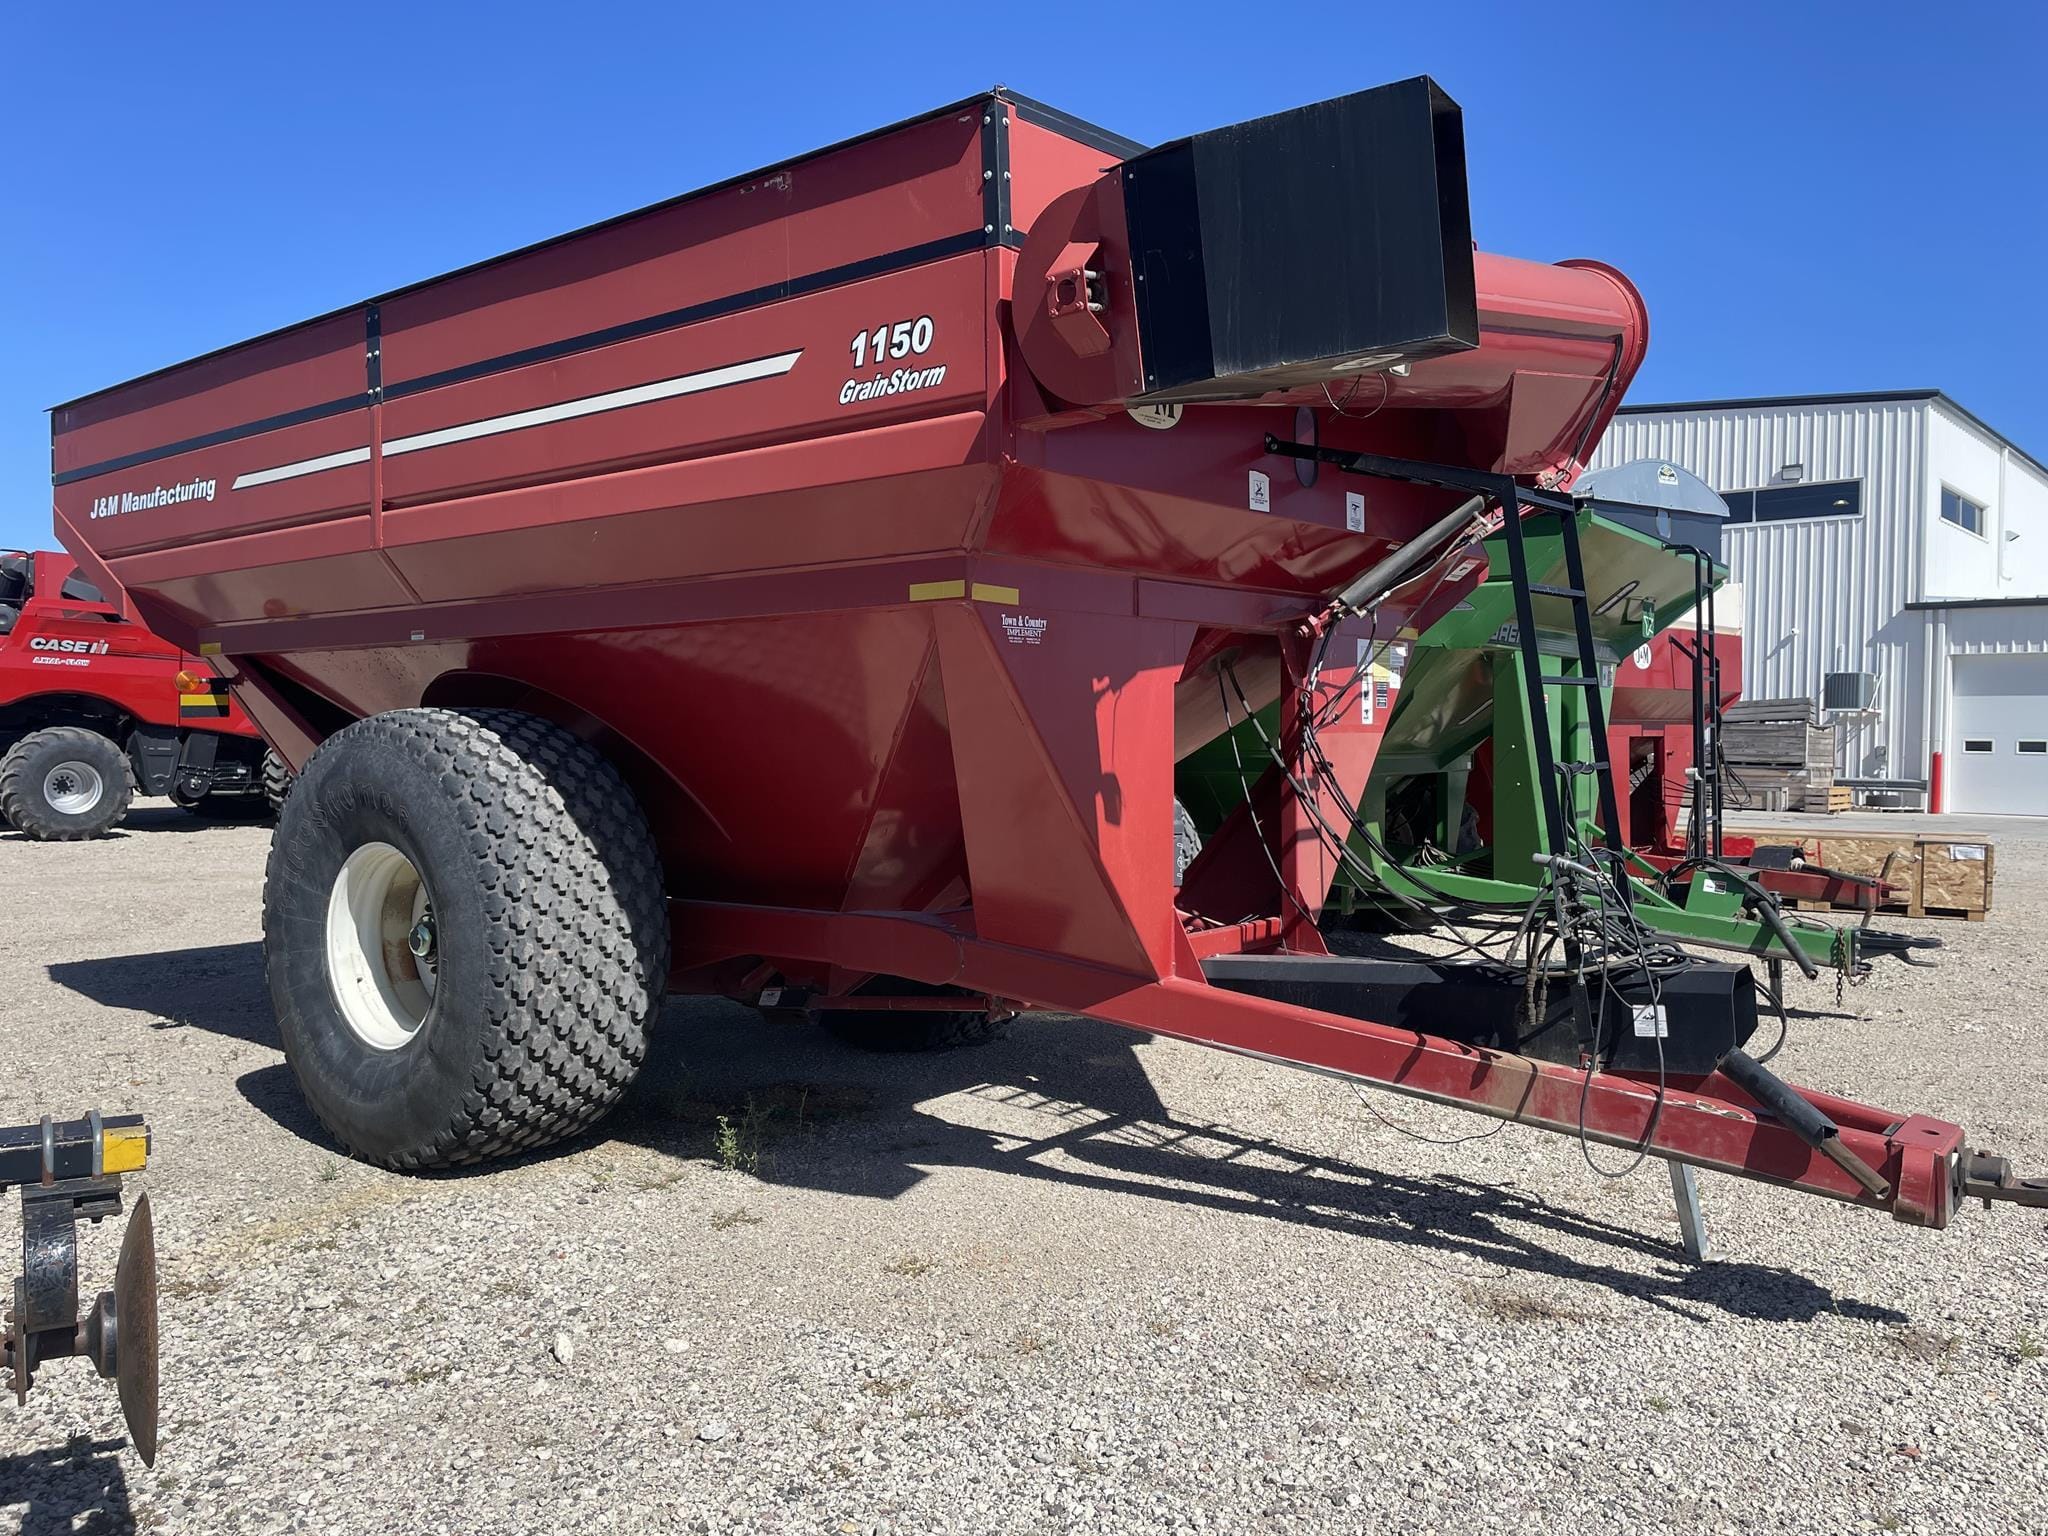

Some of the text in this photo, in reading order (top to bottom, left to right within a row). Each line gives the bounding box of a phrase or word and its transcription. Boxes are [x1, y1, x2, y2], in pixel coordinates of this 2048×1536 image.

[850, 315, 934, 368] 1150
[839, 365, 947, 405] GrainStorm
[90, 477, 216, 519] J&M Manufacturing
[1001, 613, 1047, 630] Town & Country
[1007, 628, 1042, 637] IMPLEMENT
[30, 637, 89, 653] CASE
